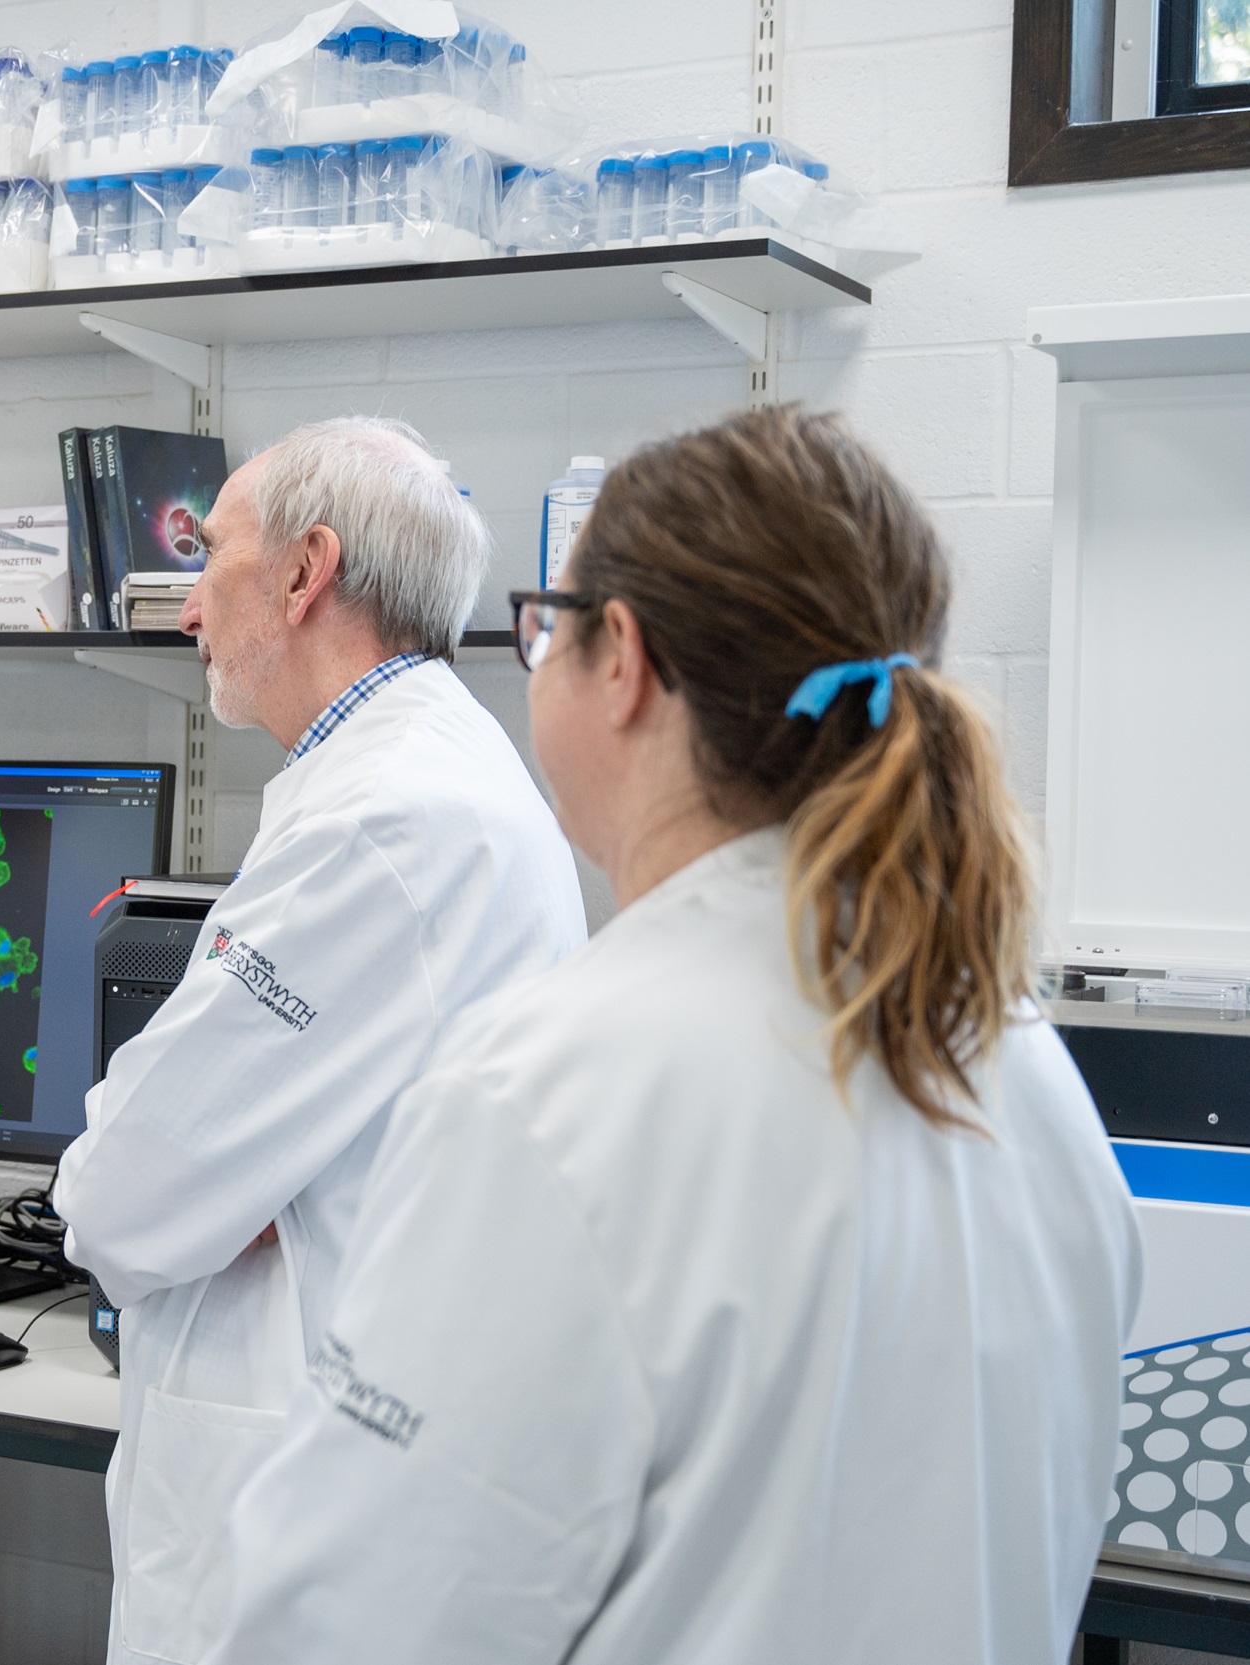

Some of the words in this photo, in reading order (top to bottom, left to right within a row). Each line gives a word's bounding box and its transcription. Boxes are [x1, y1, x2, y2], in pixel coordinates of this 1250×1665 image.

[64, 438, 75, 480] Kaluza
[92, 437, 103, 479] Kaluza
[105, 435, 116, 477] Kaluza
[17, 515, 34, 529] 50
[258, 993, 306, 1032] UNIVERSITY
